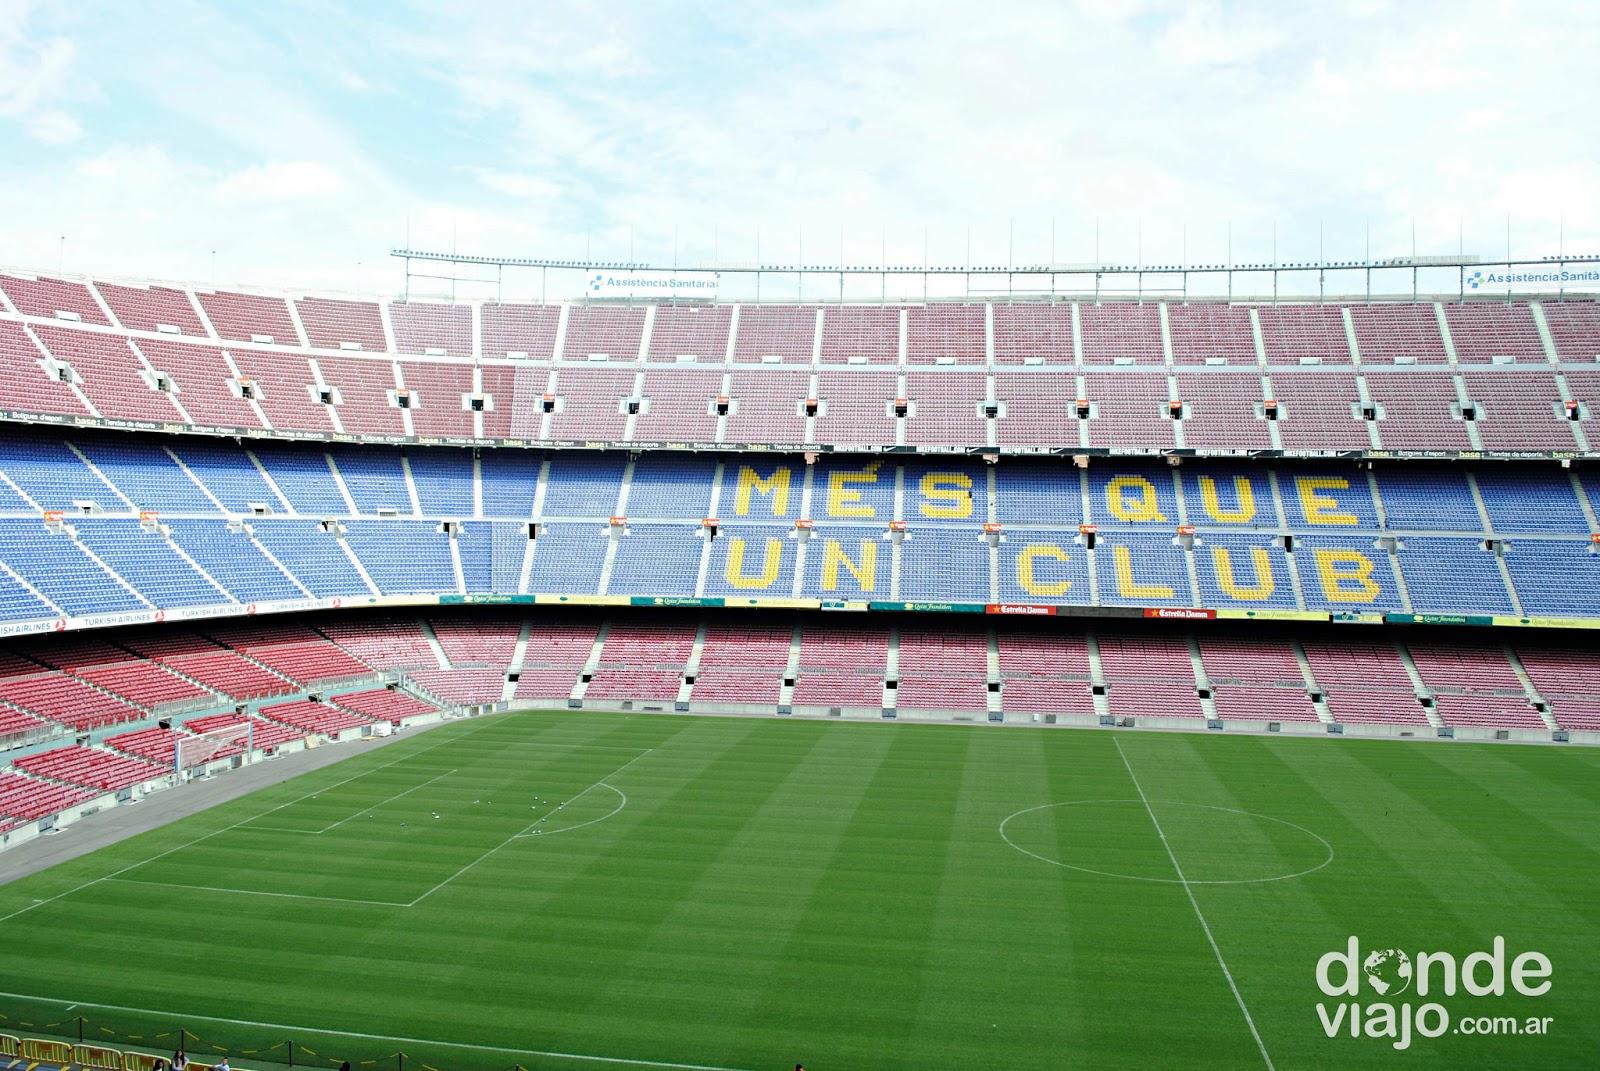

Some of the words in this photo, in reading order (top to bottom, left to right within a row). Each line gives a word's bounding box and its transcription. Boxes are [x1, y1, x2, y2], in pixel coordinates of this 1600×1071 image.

[504, 438, 526, 446] base:
[734, 461, 973, 520] MÉS
[1106, 473, 1359, 526] QUE
[724, 537, 877, 592] UN
[1016, 544, 1383, 603] CLUB
[182, 608, 212, 617] TURKISH
[213, 607, 243, 616] AIRLINES
[1001, 606, 1026, 614] Estrella
[1028, 606, 1049, 614] Damm
[1159, 609, 1185, 618] Estrella
[1186, 610, 1208, 619] Damm
[85, 616, 117, 626] TURKISH
[118, 613, 151, 623] AIRLINES
[15, 622, 51, 633] AIRLINES
